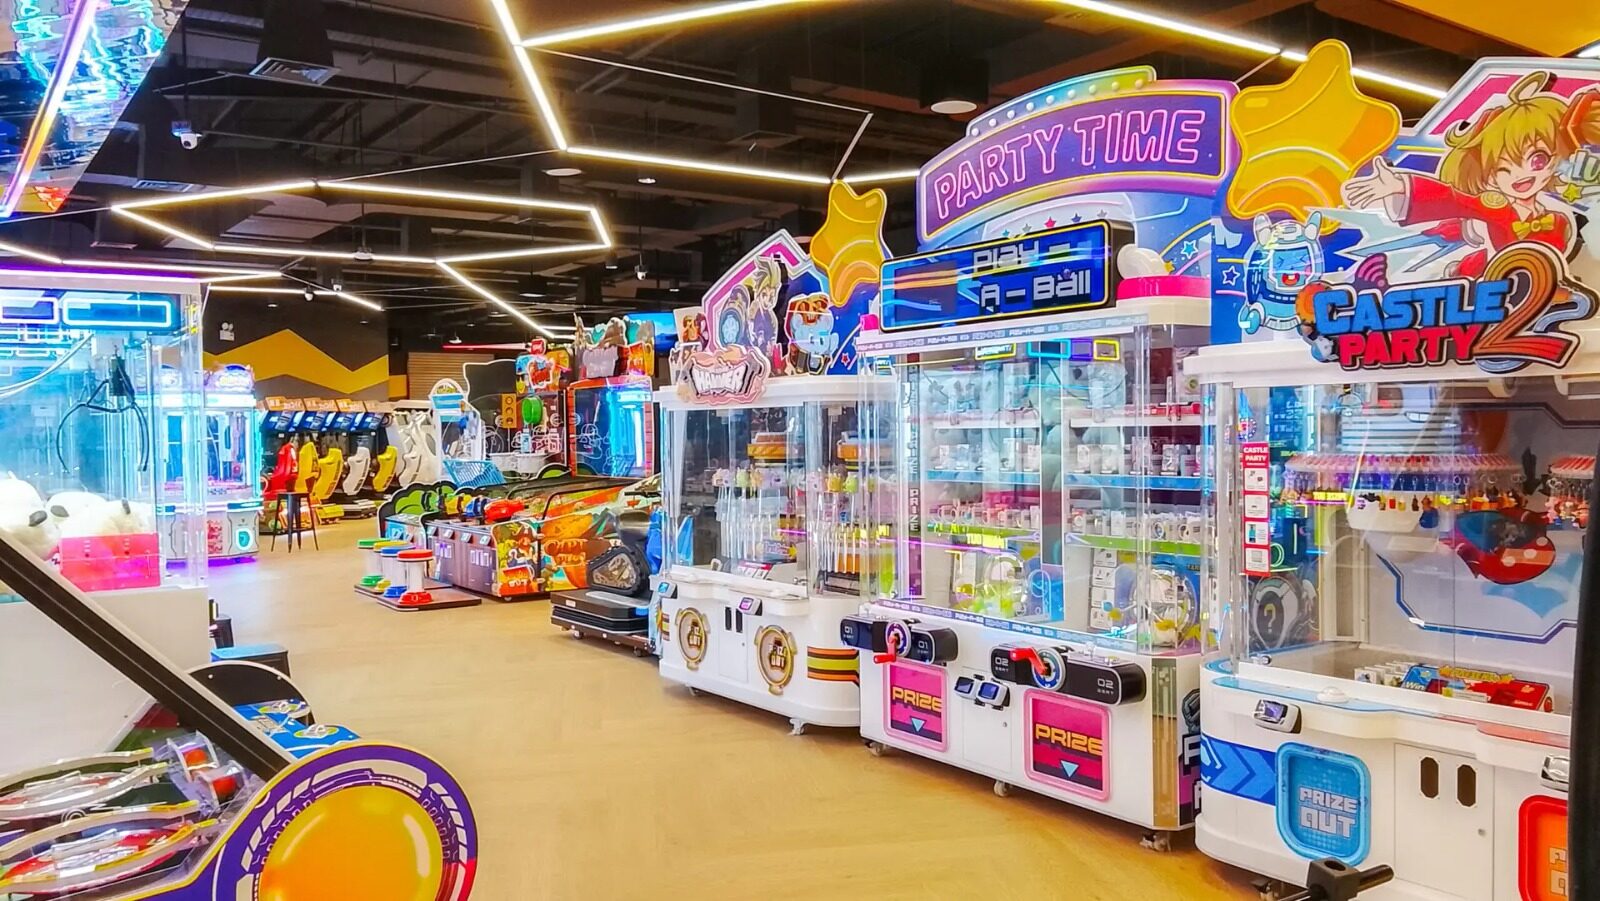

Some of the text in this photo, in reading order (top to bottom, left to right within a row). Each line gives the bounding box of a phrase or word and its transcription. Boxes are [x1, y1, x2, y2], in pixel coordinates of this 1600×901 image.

[934, 109, 1206, 220] PARTY TIME
[980, 283, 1001, 308] A
[1033, 269, 1091, 301] Ball
[1312, 278, 1513, 335] CASTLE
[1474, 245, 1573, 366] 2
[1337, 323, 1485, 366] PARTY
[1243, 446, 1268, 454] CASTLE
[1245, 454, 1267, 462] PARTY
[909, 488, 919, 531] PRIZE
[844, 625, 853, 635] 01
[918, 640, 928, 650] 01
[994, 656, 1009, 667] 02
[891, 685, 943, 711] PRIZE
[1097, 678, 1114, 690] 02
[1035, 723, 1104, 756] PRIZE
[1299, 786, 1358, 814] PRIZE
